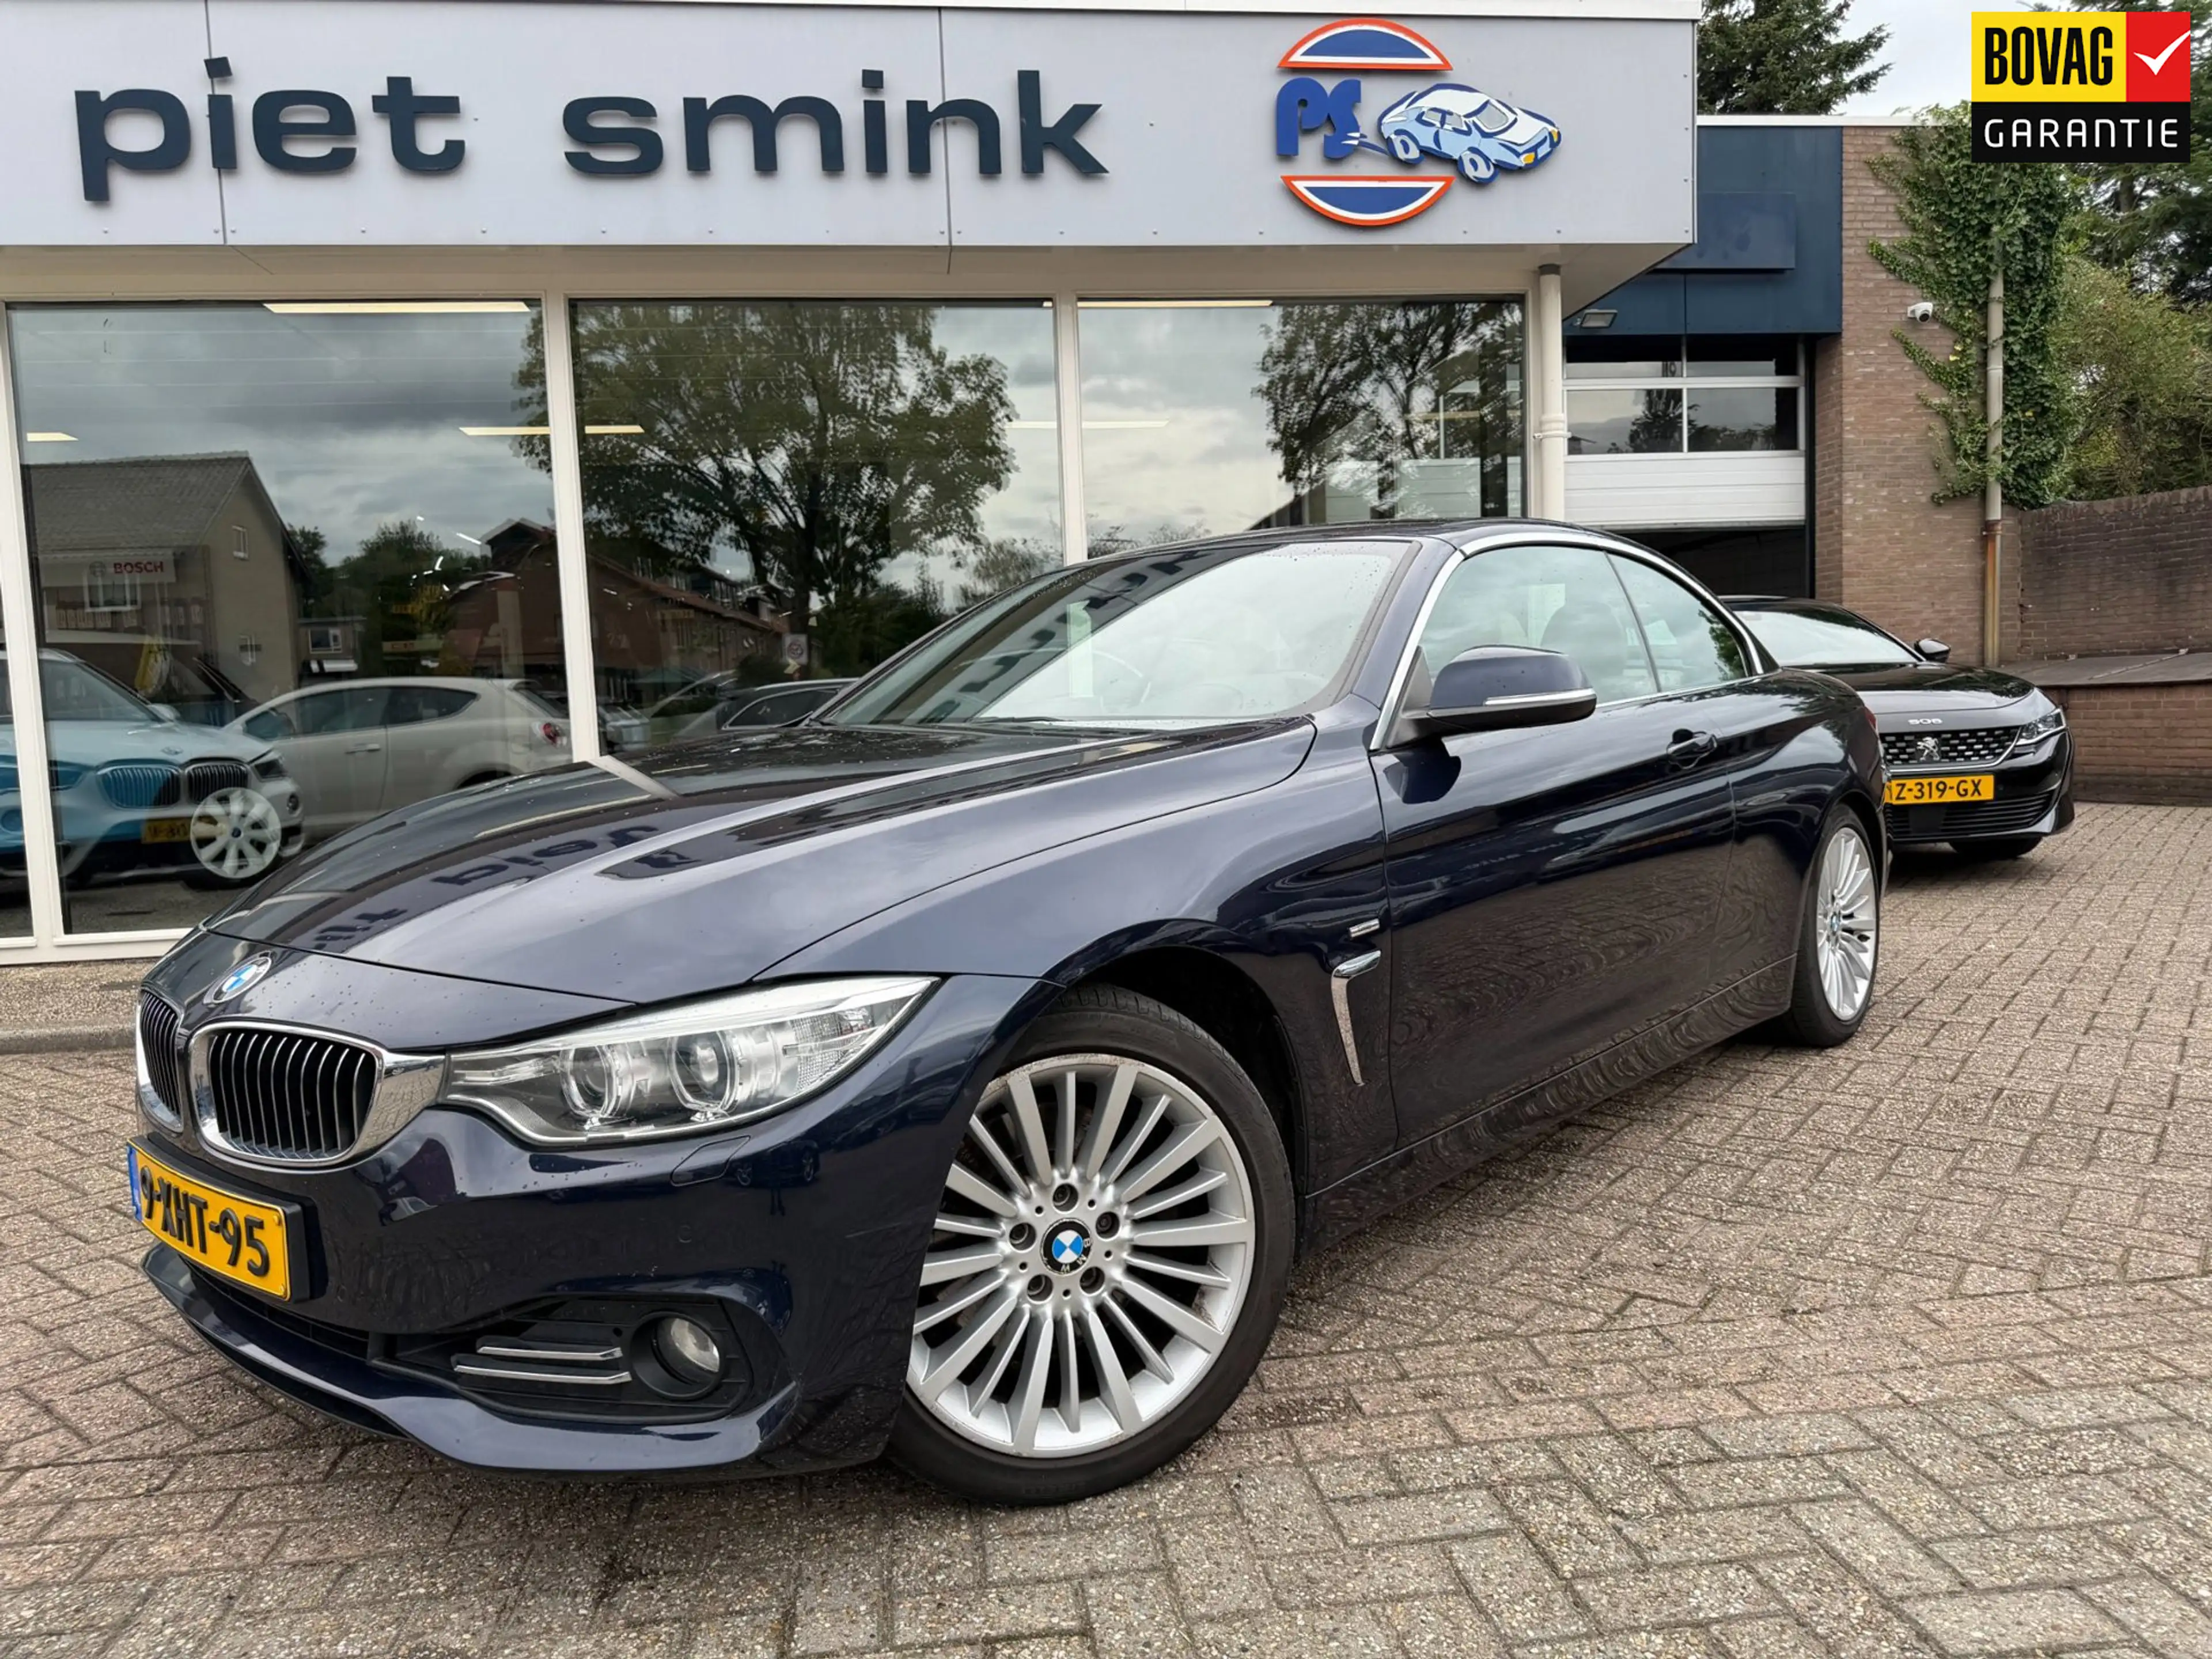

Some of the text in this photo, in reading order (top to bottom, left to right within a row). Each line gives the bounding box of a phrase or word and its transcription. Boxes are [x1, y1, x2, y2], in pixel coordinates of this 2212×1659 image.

[75, 56, 1109, 202] piet smink
[1276, 77, 1361, 160] PS
[113, 561, 164, 574] BOSCH
[1895, 779, 1982, 800] Z-319-GX
[140, 1165, 270, 1277] 9-XHT-95
